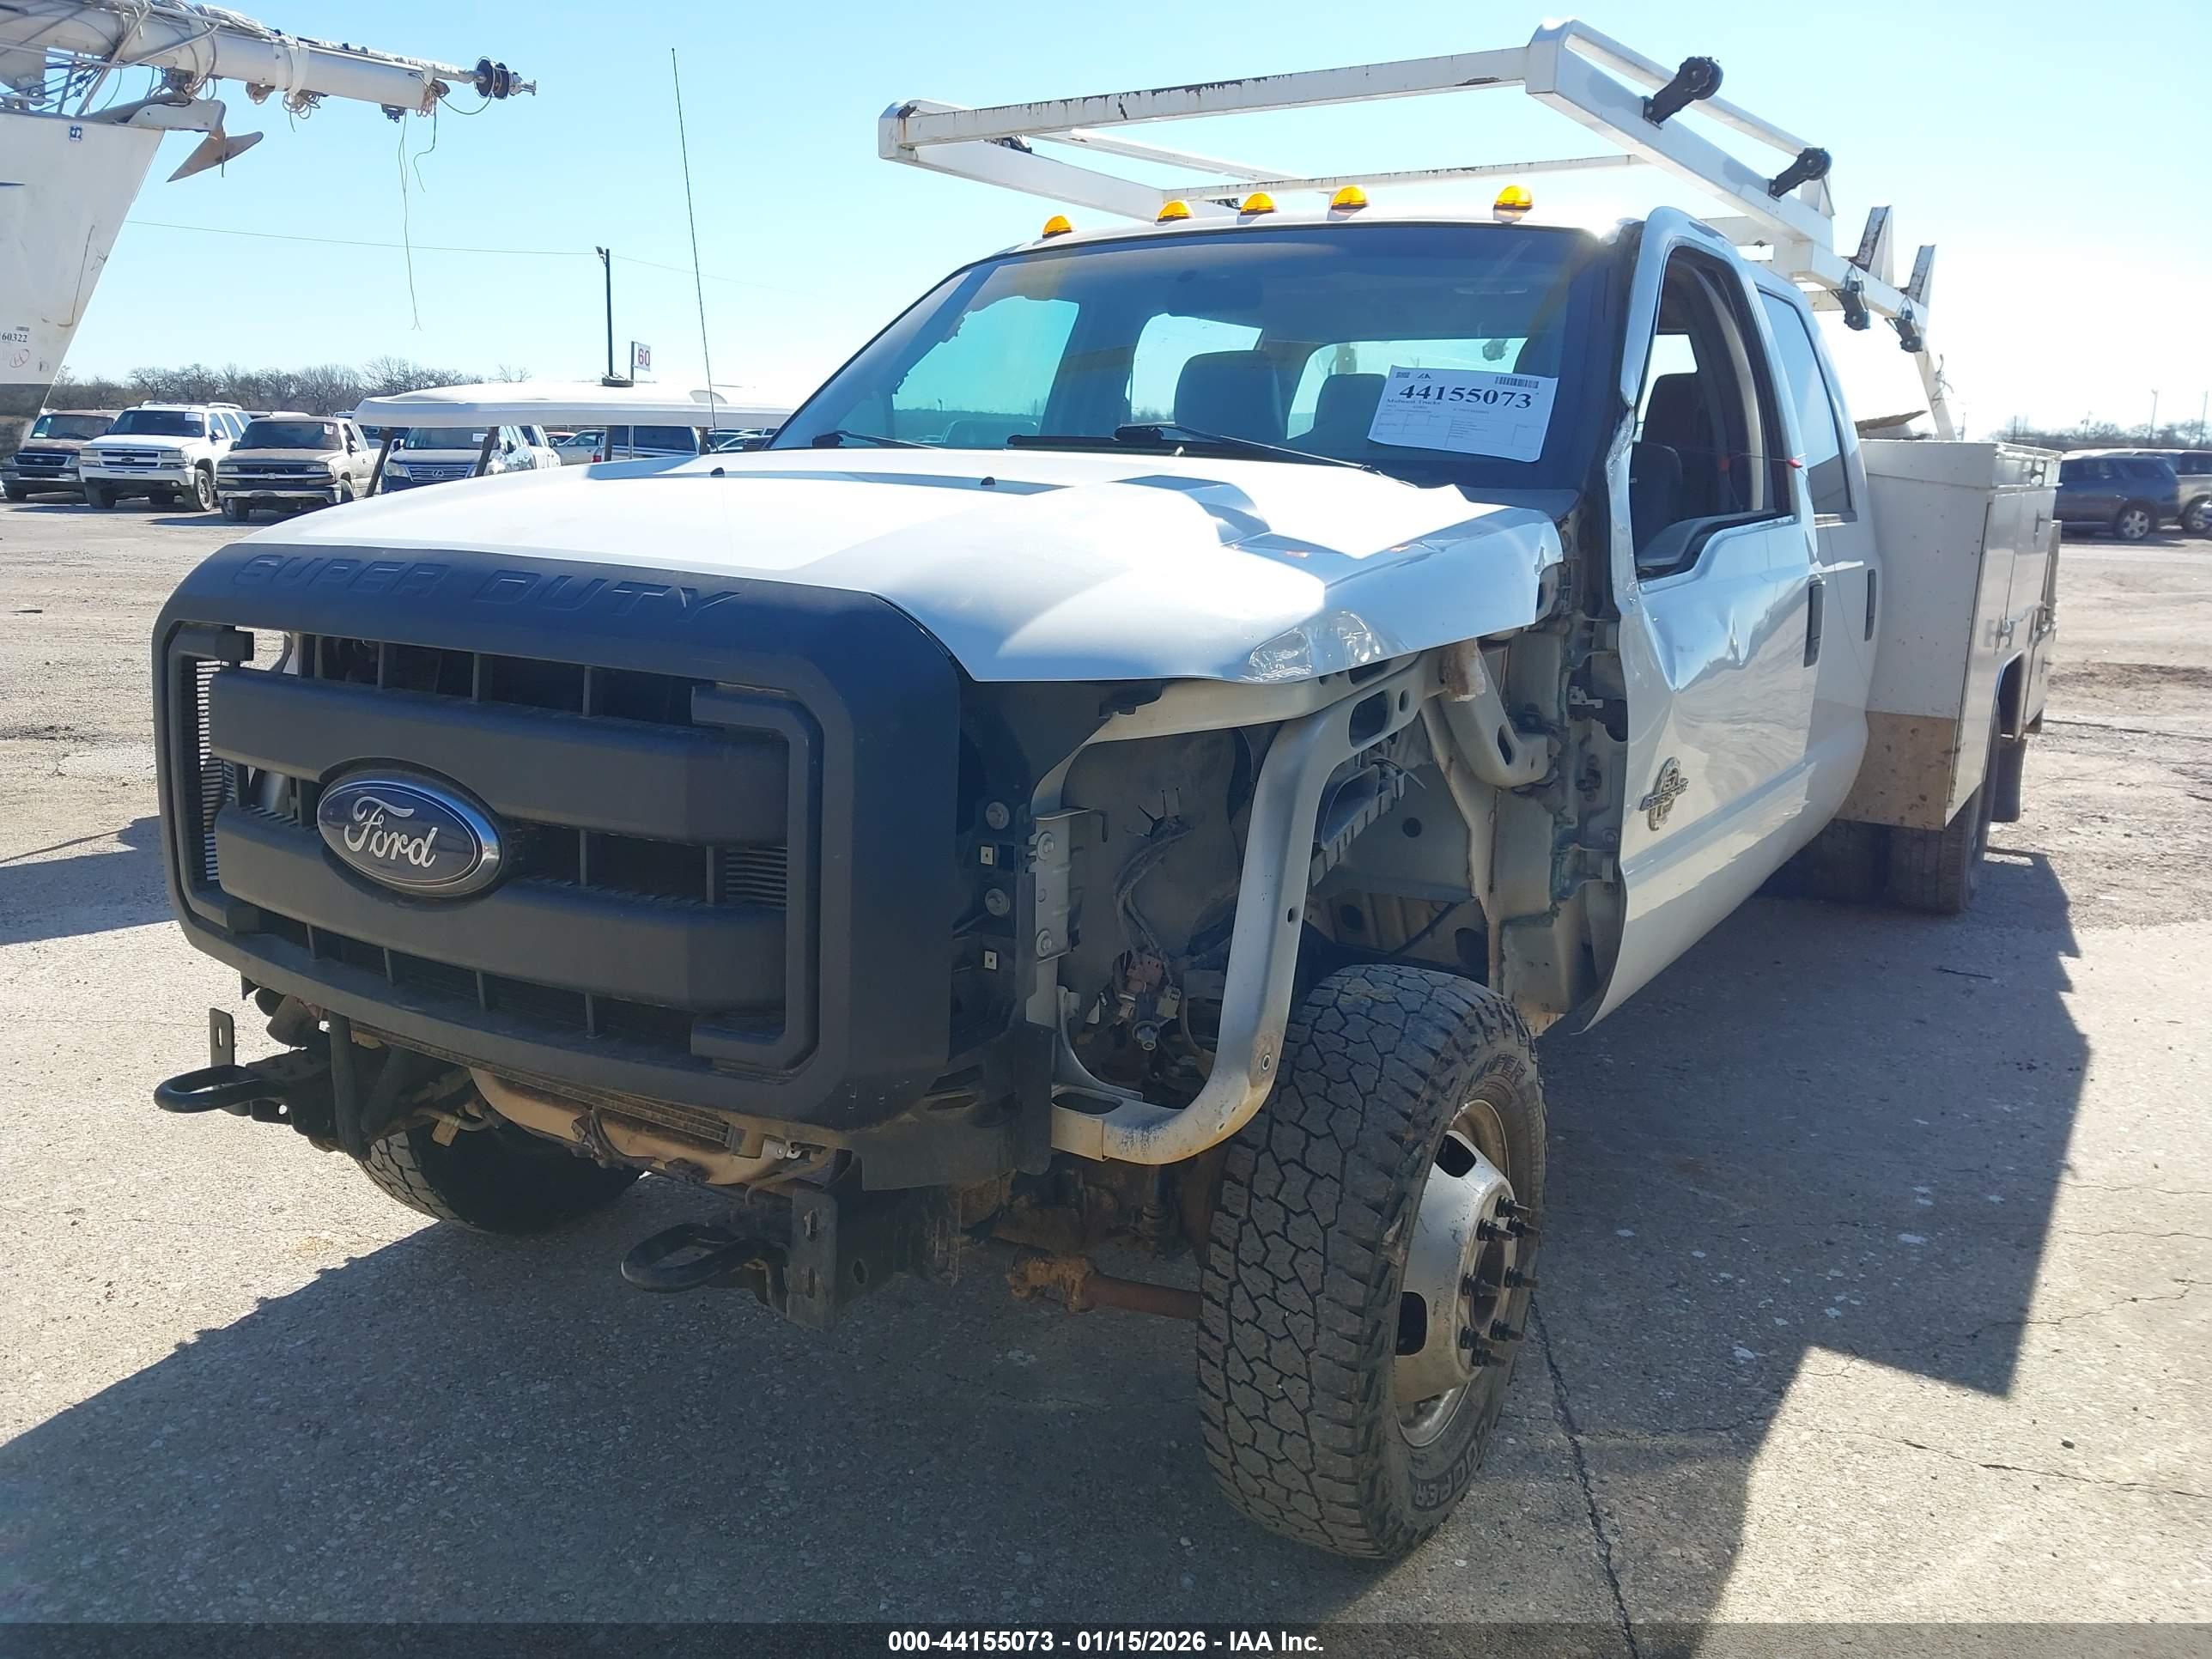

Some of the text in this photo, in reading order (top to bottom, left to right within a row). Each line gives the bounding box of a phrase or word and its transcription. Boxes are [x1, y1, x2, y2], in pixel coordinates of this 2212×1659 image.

[638, 348, 651, 367] 60
[1399, 384, 1532, 409] 44155073
[233, 554, 741, 623] SUPER DUTY
[343, 795, 439, 868] Ford
